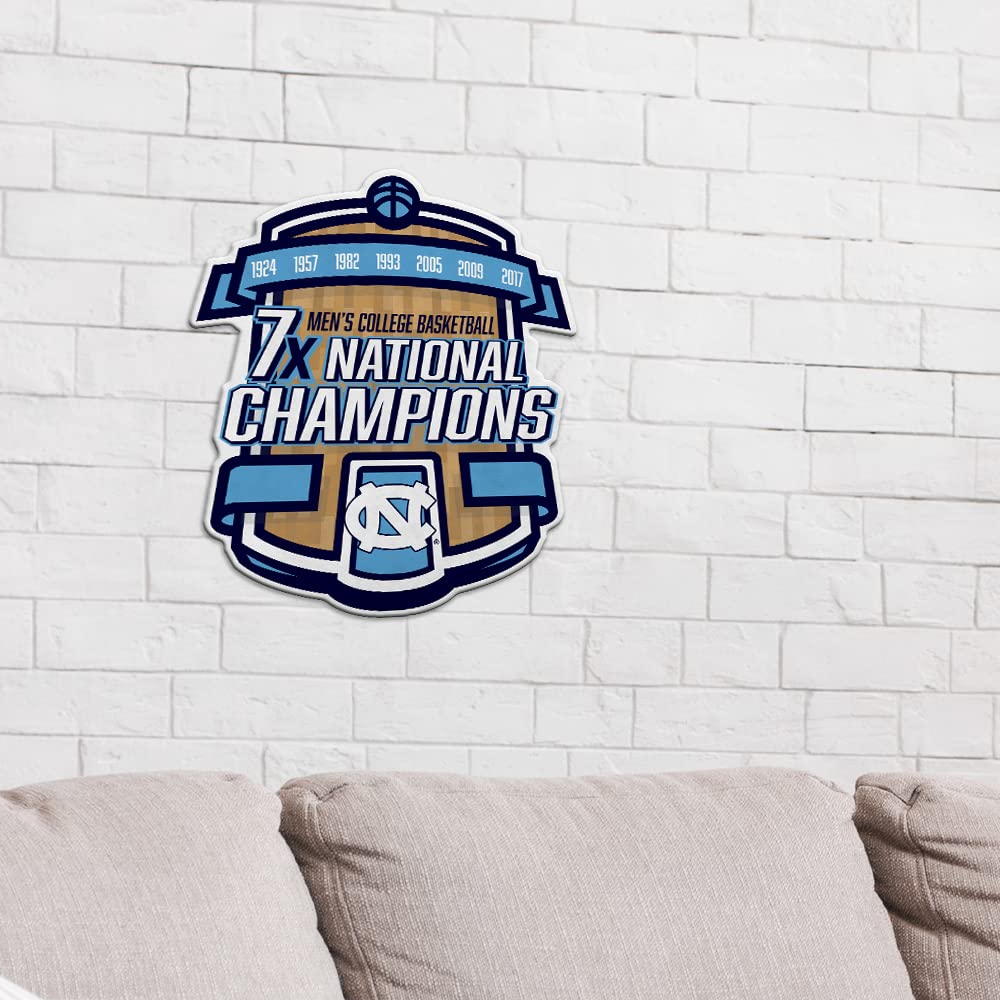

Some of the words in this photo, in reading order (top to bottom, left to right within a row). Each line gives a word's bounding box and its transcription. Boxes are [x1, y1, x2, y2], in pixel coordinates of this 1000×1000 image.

[251, 257, 277, 279] 1924
[294, 254, 319, 273] 1957
[334, 252, 360, 271] 1982
[375, 252, 401, 271] 1993
[416, 254, 443, 274] 2005
[457, 259, 484, 280] 2009
[501, 267, 524, 288] 2017
[306, 311, 355, 333] MEN'S
[357, 311, 414, 334] COLLEGE
[416, 312, 495, 336] BASKETBALL
[325, 337, 528, 384] NATIONAL
[222, 385, 558, 446] CHAMPIONS
